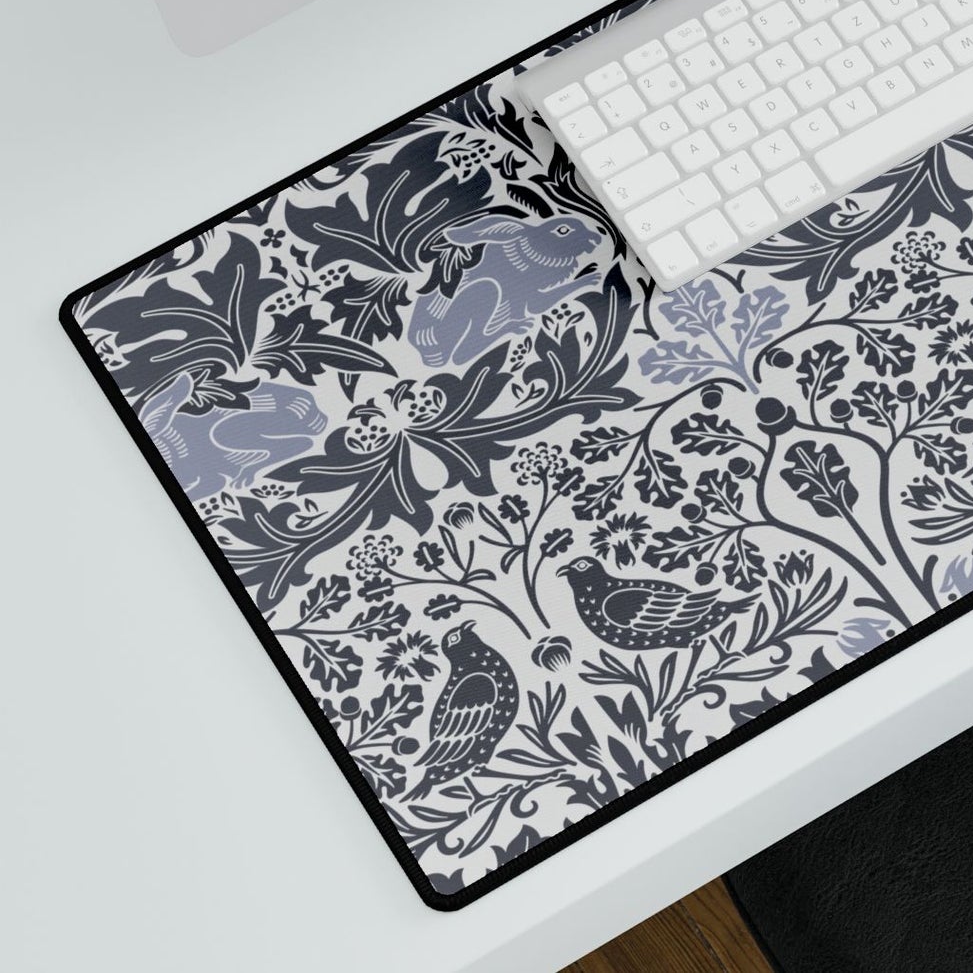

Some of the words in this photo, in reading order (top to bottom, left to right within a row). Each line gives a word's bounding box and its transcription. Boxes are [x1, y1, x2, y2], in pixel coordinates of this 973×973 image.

[759, 16, 768, 25] 5
[852, 16, 862, 27] Z
[922, 17, 928, 27] J
[722, 37, 730, 45] 4
[748, 38, 756, 47] $
[814, 37, 822, 46] T
[880, 38, 892, 48] H
[961, 37, 973, 49] M
[682, 58, 691, 67] 3
[775, 59, 786, 68] R
[843, 59, 854, 69] G
[923, 58, 935, 69] N
[643, 79, 653, 88] 2
[737, 79, 747, 89] E
[805, 80, 812, 90] F
[885, 80, 896, 90] B
[604, 100, 612, 109] 1
[696, 99, 709, 111] W
[766, 101, 776, 111] D
[846, 100, 856, 110] V
[659, 121, 671, 131] Q
[728, 122, 737, 132] S
[808, 121, 820, 132] C
[690, 144, 700, 154] A
[769, 143, 781, 154] X
[730, 164, 739, 174] Y
